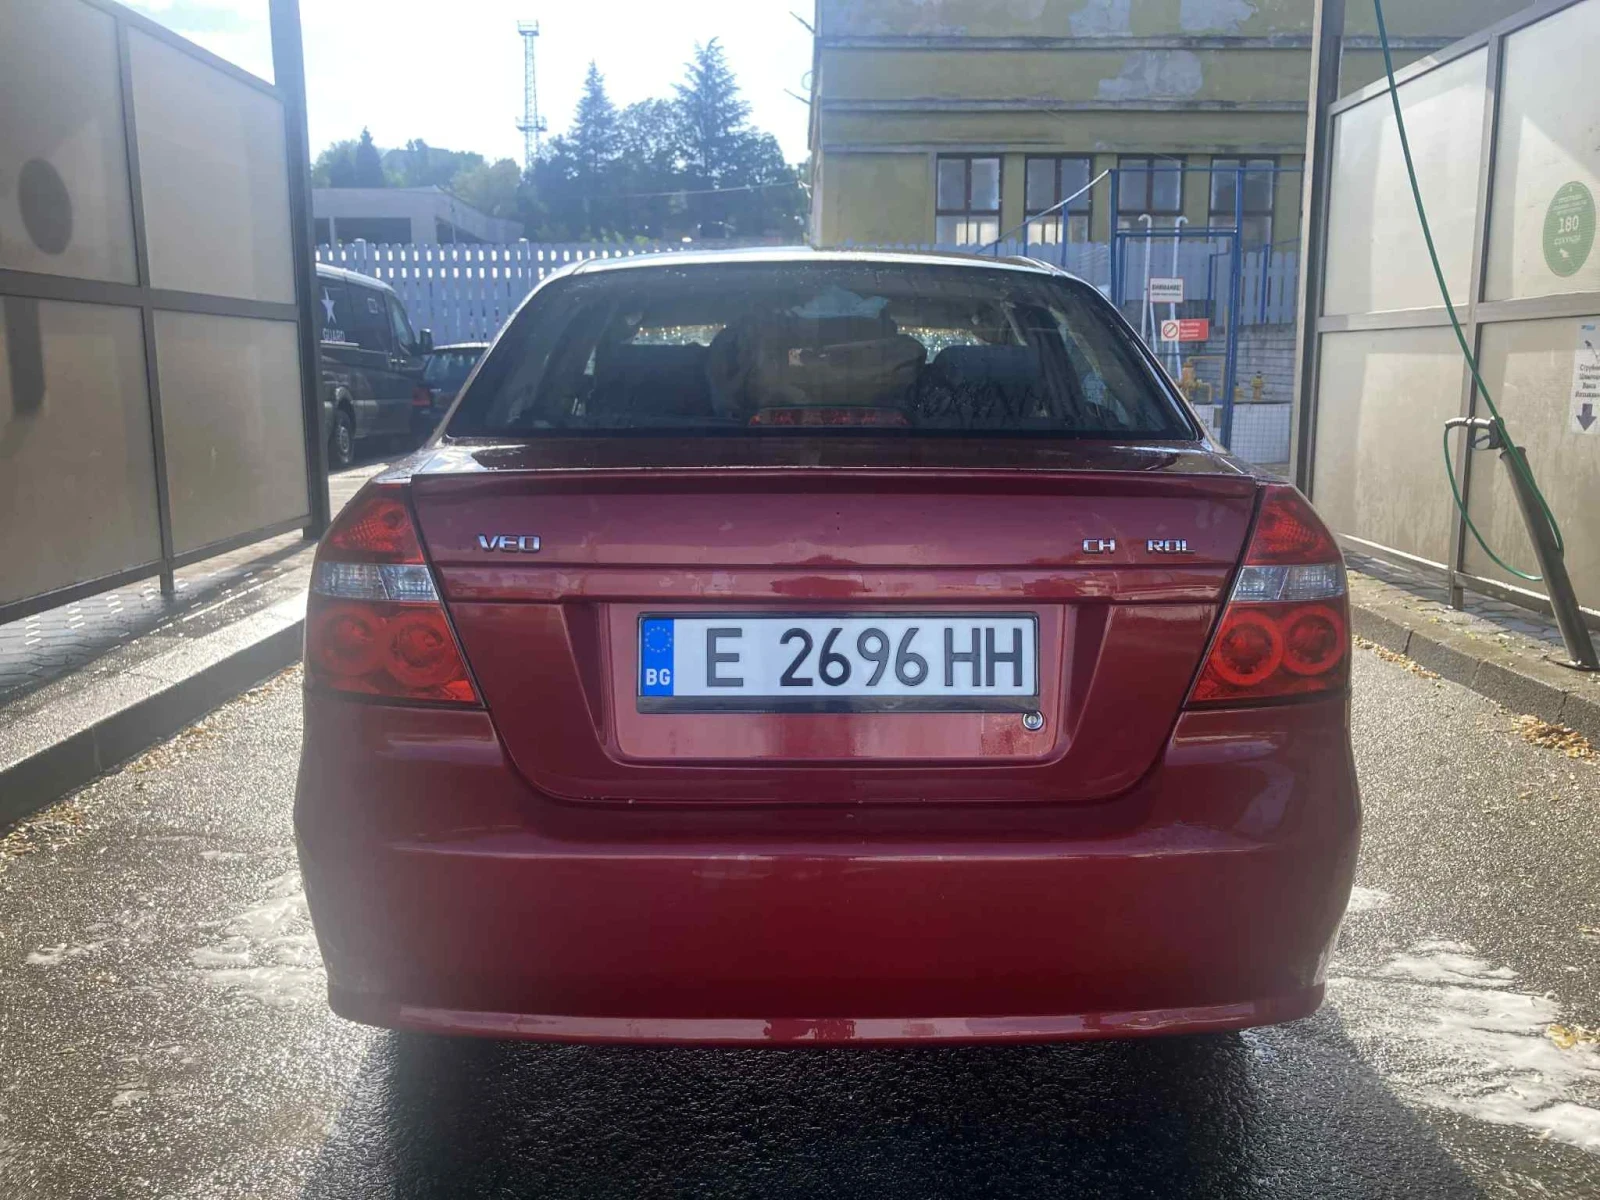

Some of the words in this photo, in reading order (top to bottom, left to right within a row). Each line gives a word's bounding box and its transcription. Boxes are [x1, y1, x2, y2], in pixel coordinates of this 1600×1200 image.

[1557, 215, 1579, 233] 180
[706, 627, 743, 687] E
[779, 627, 928, 687] 2696
[944, 627, 1022, 687] HH
[646, 668, 670, 685] BG
